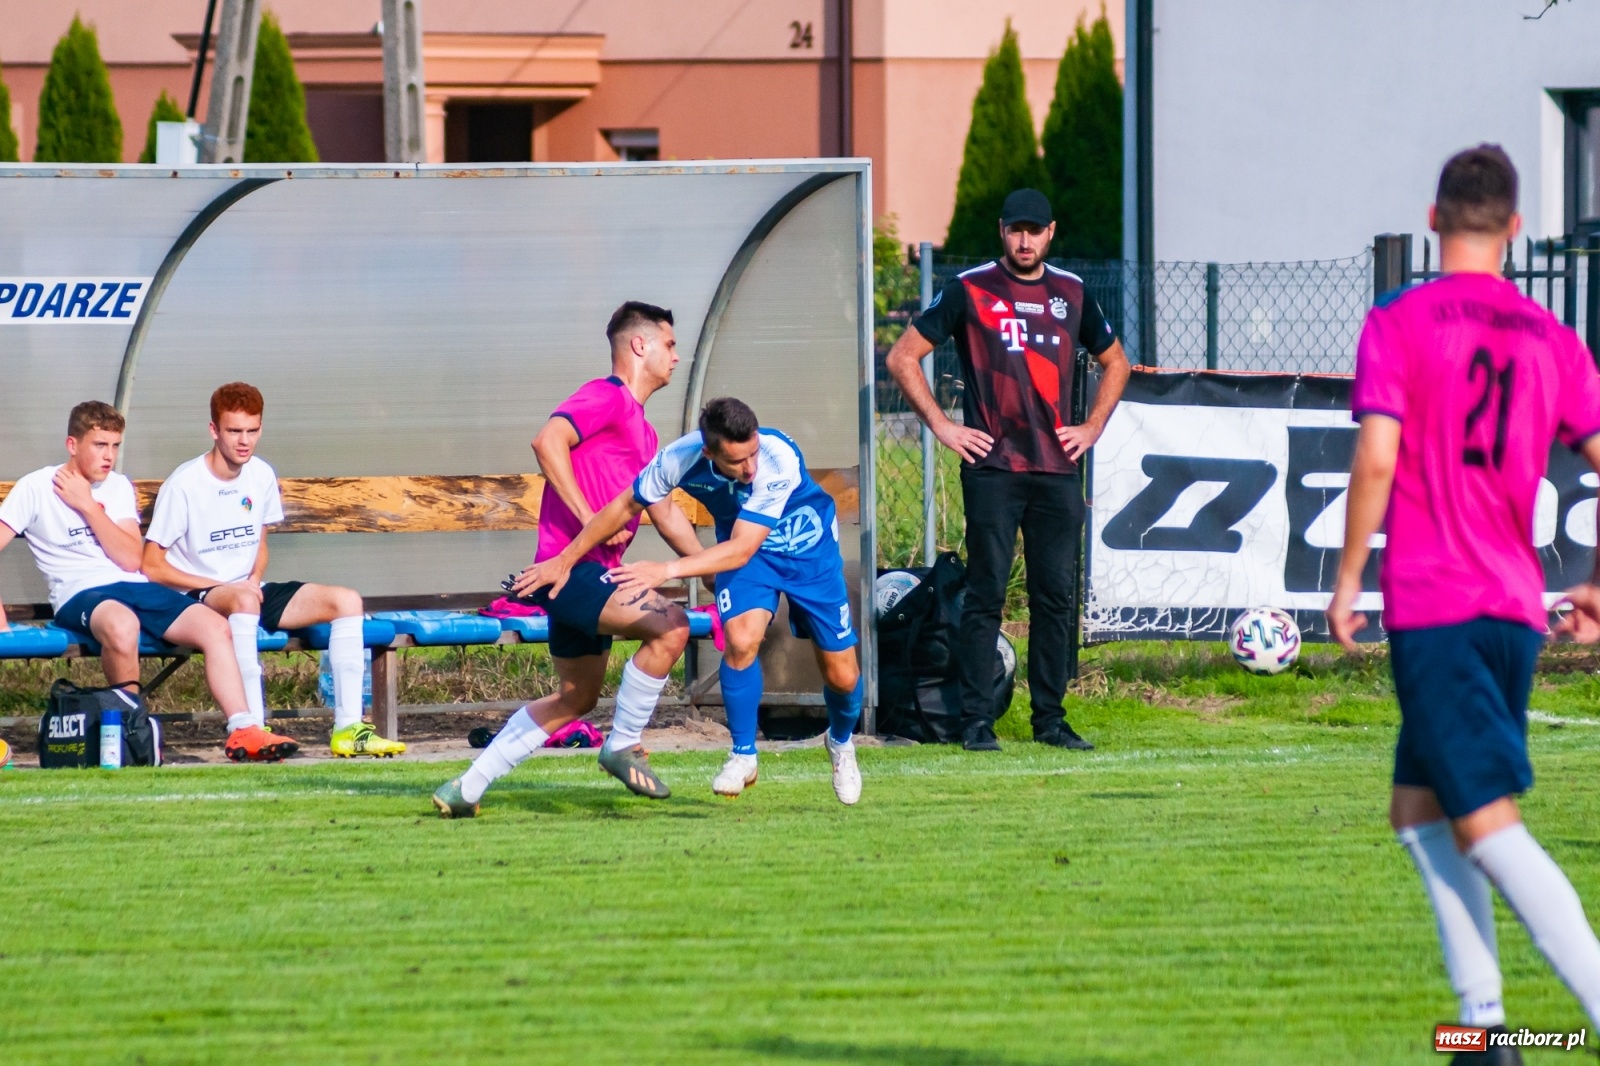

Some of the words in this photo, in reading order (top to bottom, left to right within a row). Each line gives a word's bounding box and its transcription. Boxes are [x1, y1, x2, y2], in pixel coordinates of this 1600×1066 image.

[788, 20, 814, 49] 24
[0, 283, 142, 317] PDARZE
[1462, 347, 1515, 471] 21
[210, 525, 254, 542] EFCE
[48, 713, 86, 738] SELECT
